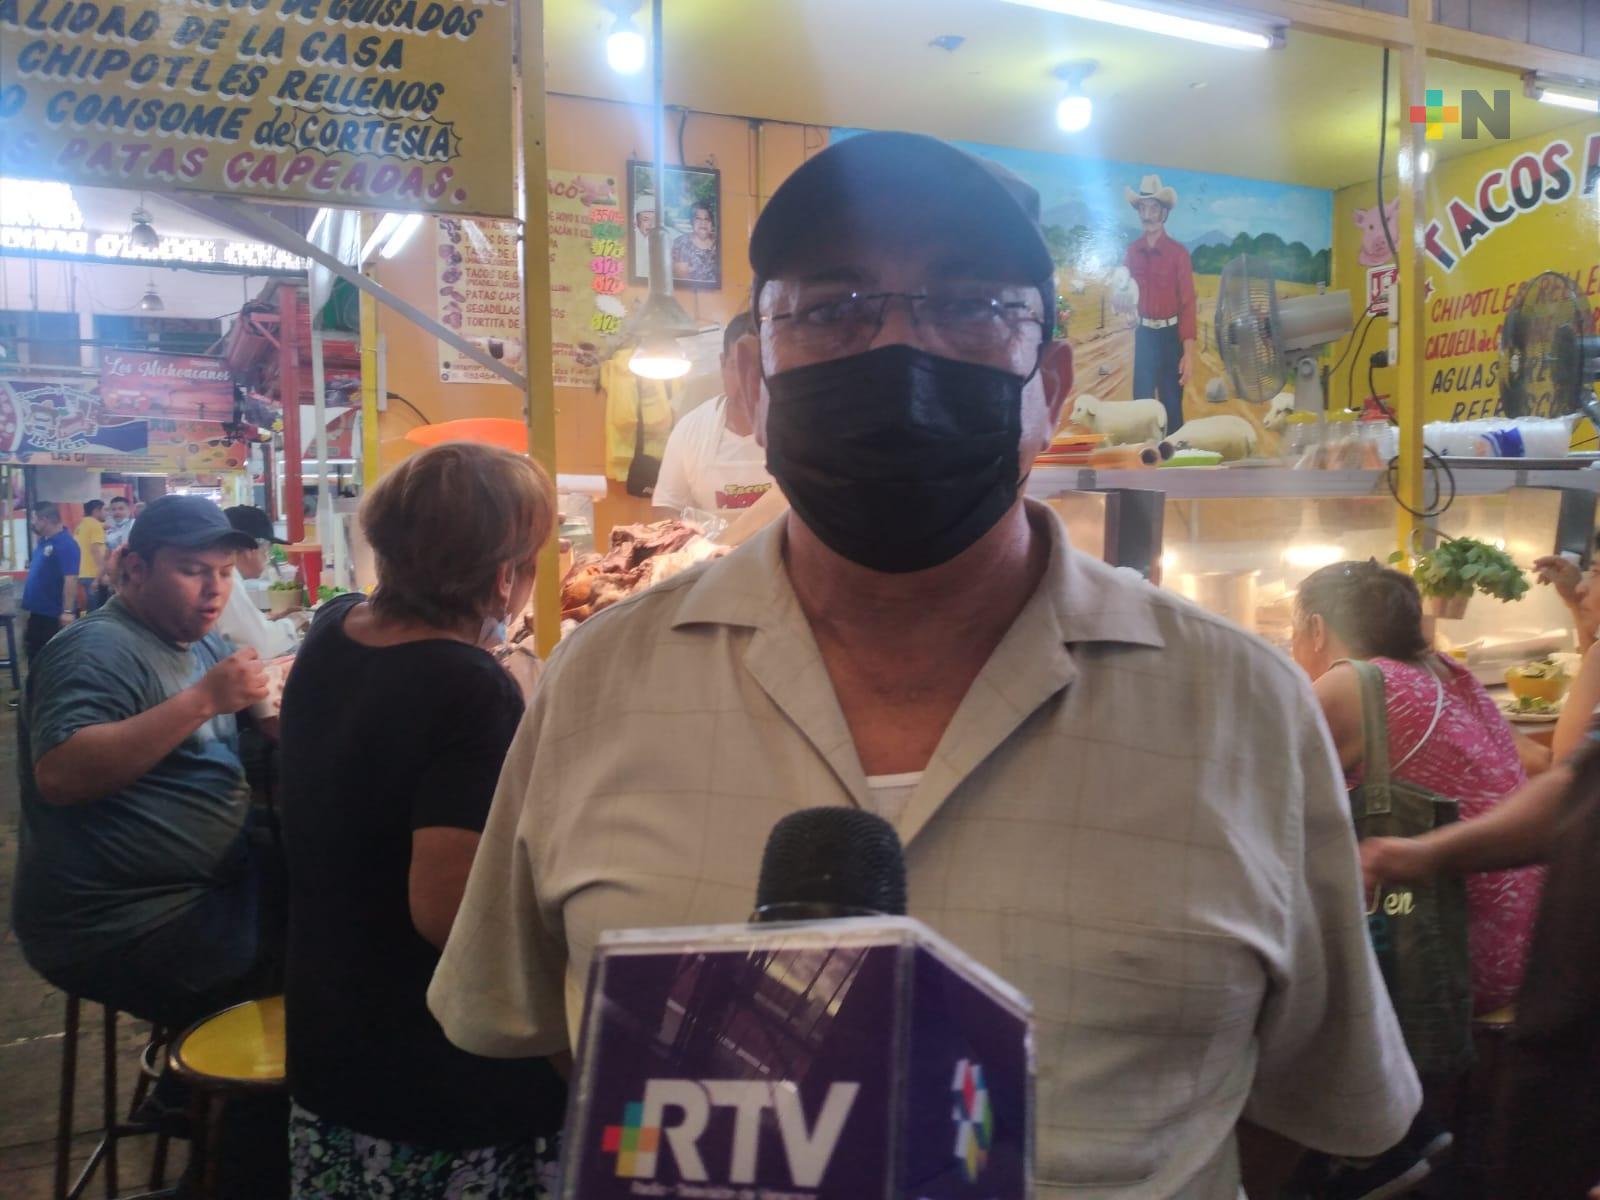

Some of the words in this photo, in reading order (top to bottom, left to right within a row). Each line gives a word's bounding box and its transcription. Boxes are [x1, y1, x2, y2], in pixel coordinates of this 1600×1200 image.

[0, 0, 160, 42] ALIDAD
[174, 16, 230, 50] DE
[239, 25, 286, 59] LA
[300, 31, 404, 70] CASA
[328, 0, 483, 37] GUISADOS
[17, 40, 268, 97] CHIPOTLES
[277, 69, 445, 116] RELLENOS
[47, 91, 251, 140] CONSOME
[254, 106, 292, 147] de
[296, 115, 449, 158] CORTESIA
[57, 138, 208, 177] PATAS
[227, 152, 467, 201] CAPEADAS.
[1422, 139, 1574, 270] TACOS
[466, 290, 497, 301] PATAS
[499, 291, 521, 301] CAPE
[1425, 328, 1476, 361] CAZUELA
[1431, 361, 1499, 394] AGUAS
[620, 1078, 861, 1187] RTV
